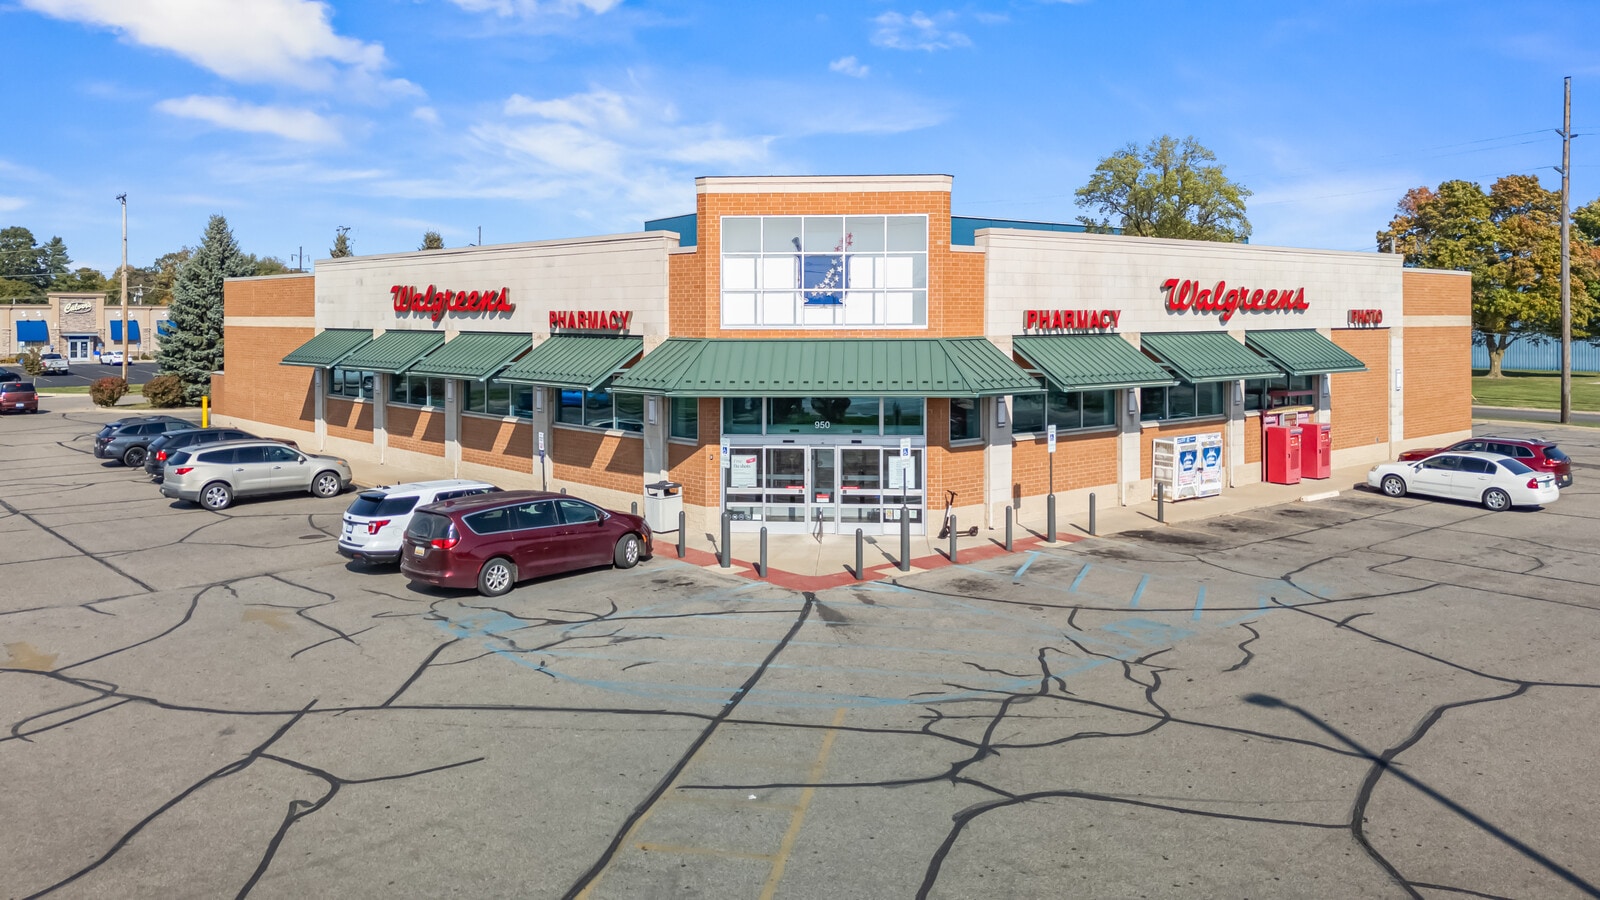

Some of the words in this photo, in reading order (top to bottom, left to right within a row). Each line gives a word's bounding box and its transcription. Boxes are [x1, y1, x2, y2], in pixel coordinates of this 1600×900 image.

[390, 284, 512, 322] Walgreens
[1163, 278, 1310, 321] Walgreens
[549, 310, 630, 330] PHARMACY
[1026, 310, 1121, 329] PHARMACY
[1350, 309, 1383, 324] PHOTO
[814, 420, 831, 429] 950
